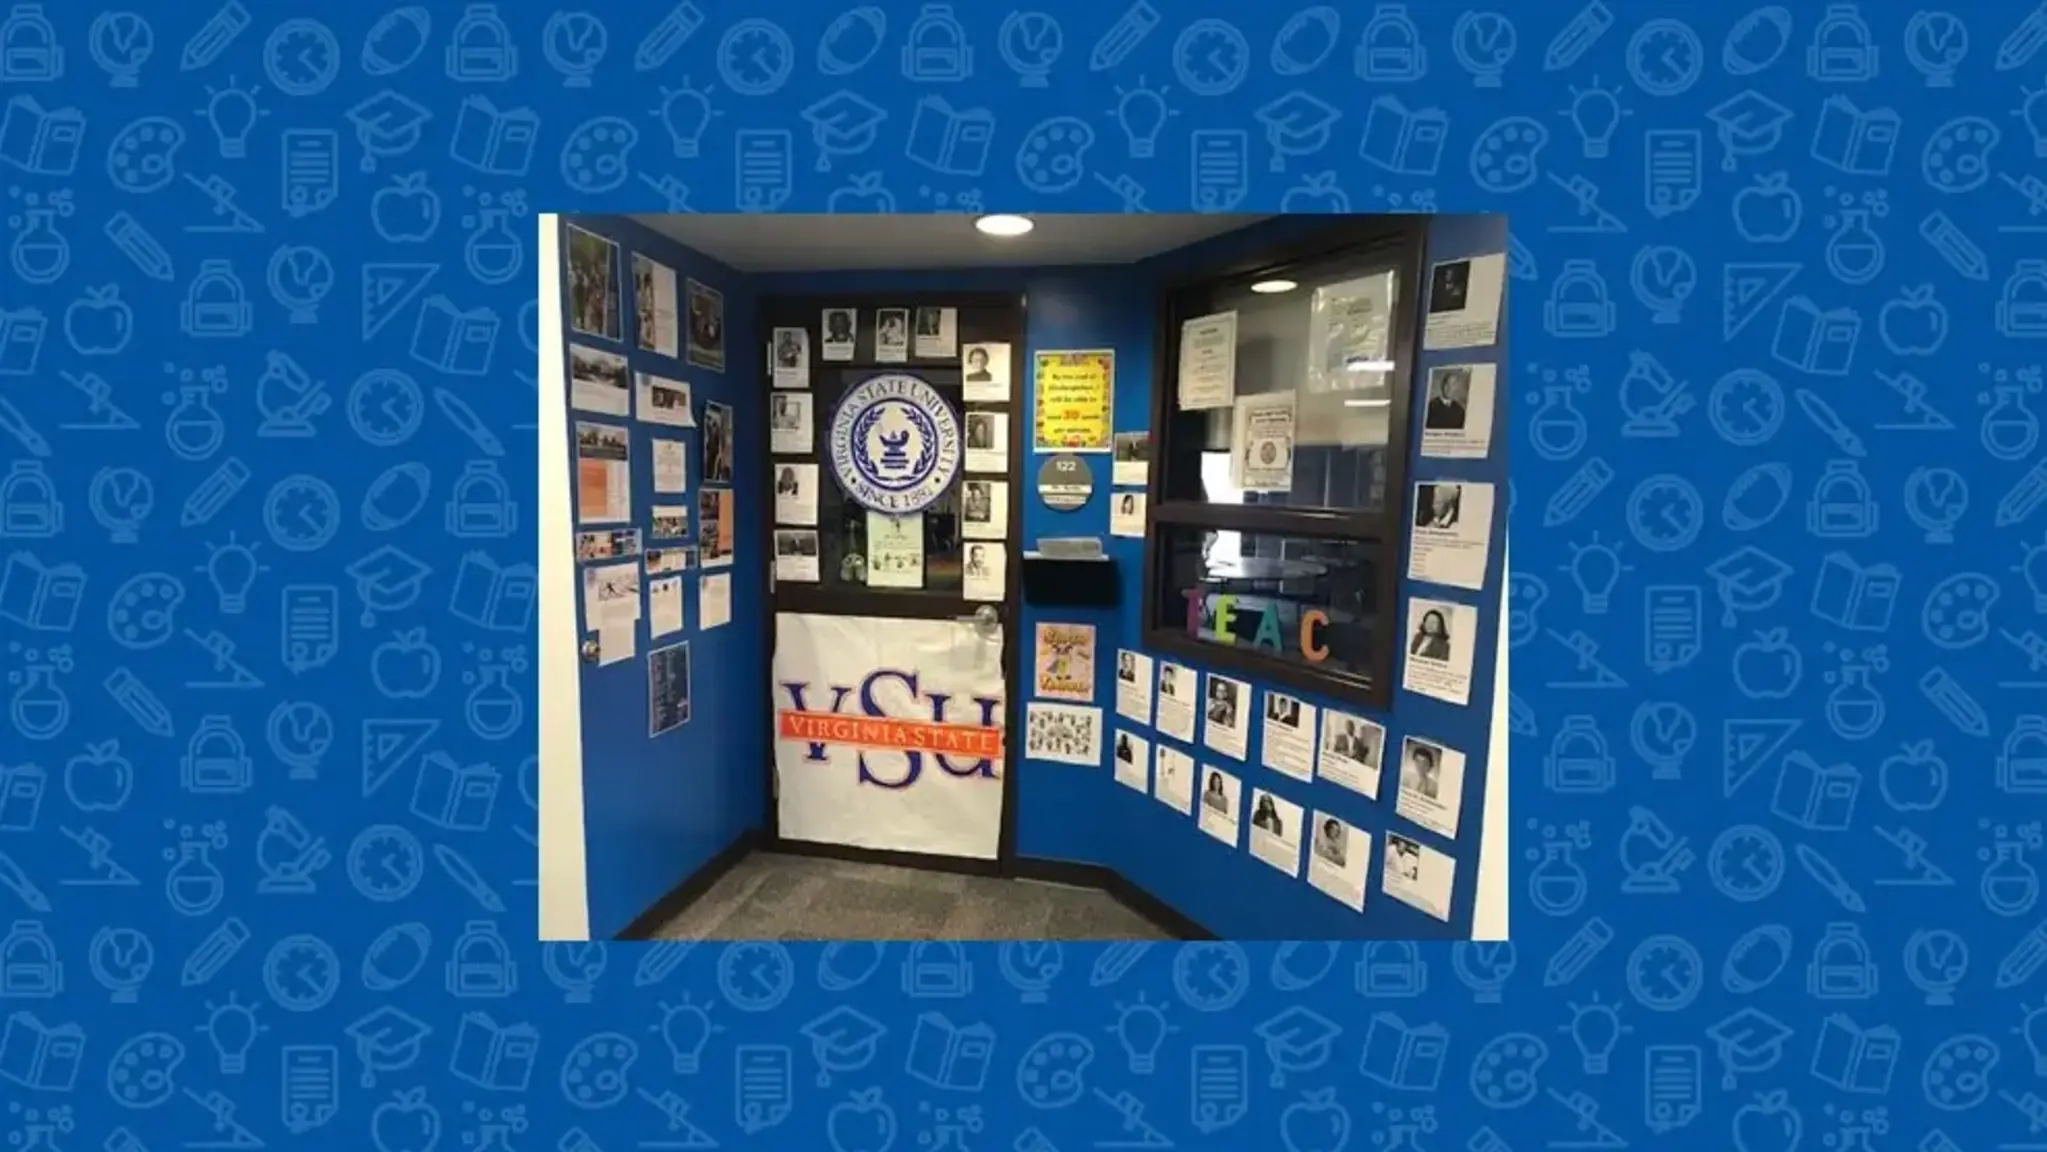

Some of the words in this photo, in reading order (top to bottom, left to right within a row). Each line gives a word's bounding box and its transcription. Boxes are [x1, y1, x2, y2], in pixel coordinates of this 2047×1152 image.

[836, 402, 859, 478] VIRGINIA
[857, 380, 907, 405] STATE
[909, 383, 956, 476] UNIVERSITY
[1056, 461, 1077, 471] 122
[856, 483, 898, 509] SINCE
[779, 668, 1001, 790] VSU
[790, 715, 909, 746] VIRGINIA
[912, 727, 994, 751] STATE
